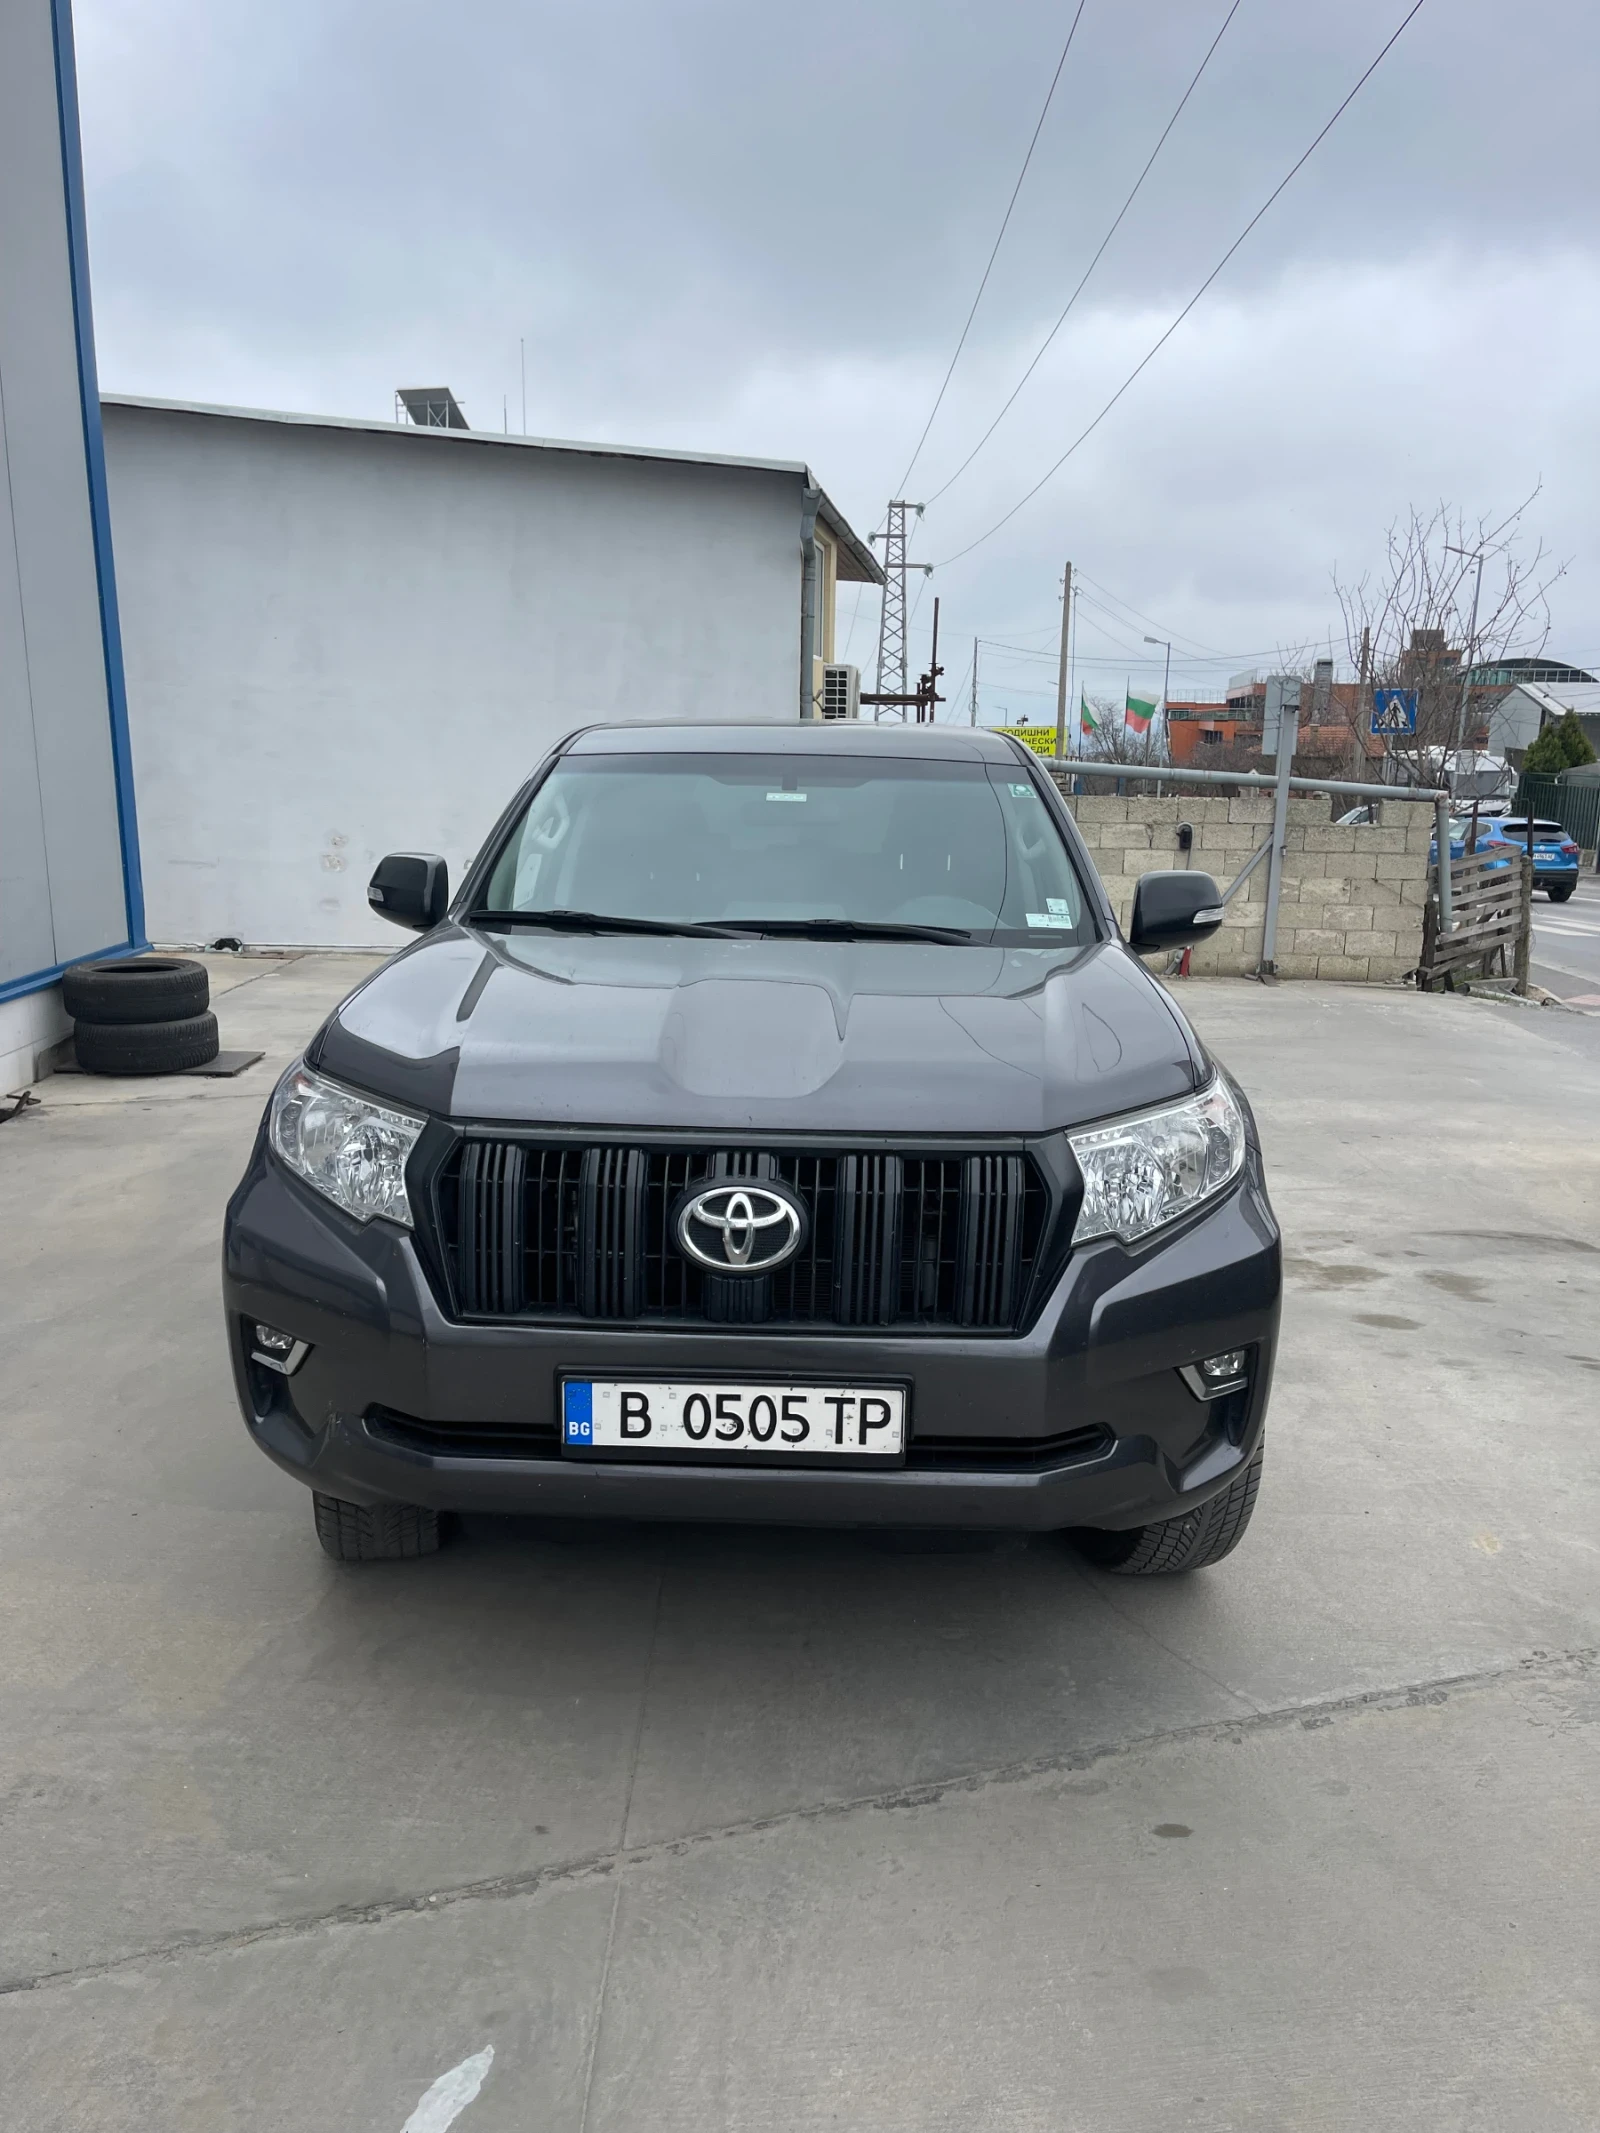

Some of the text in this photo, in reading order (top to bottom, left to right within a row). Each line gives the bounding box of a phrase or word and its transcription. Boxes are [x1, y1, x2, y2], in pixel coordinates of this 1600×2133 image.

[568, 1421, 591, 1436] BG
[620, 1391, 892, 1446] B 0505 TP
